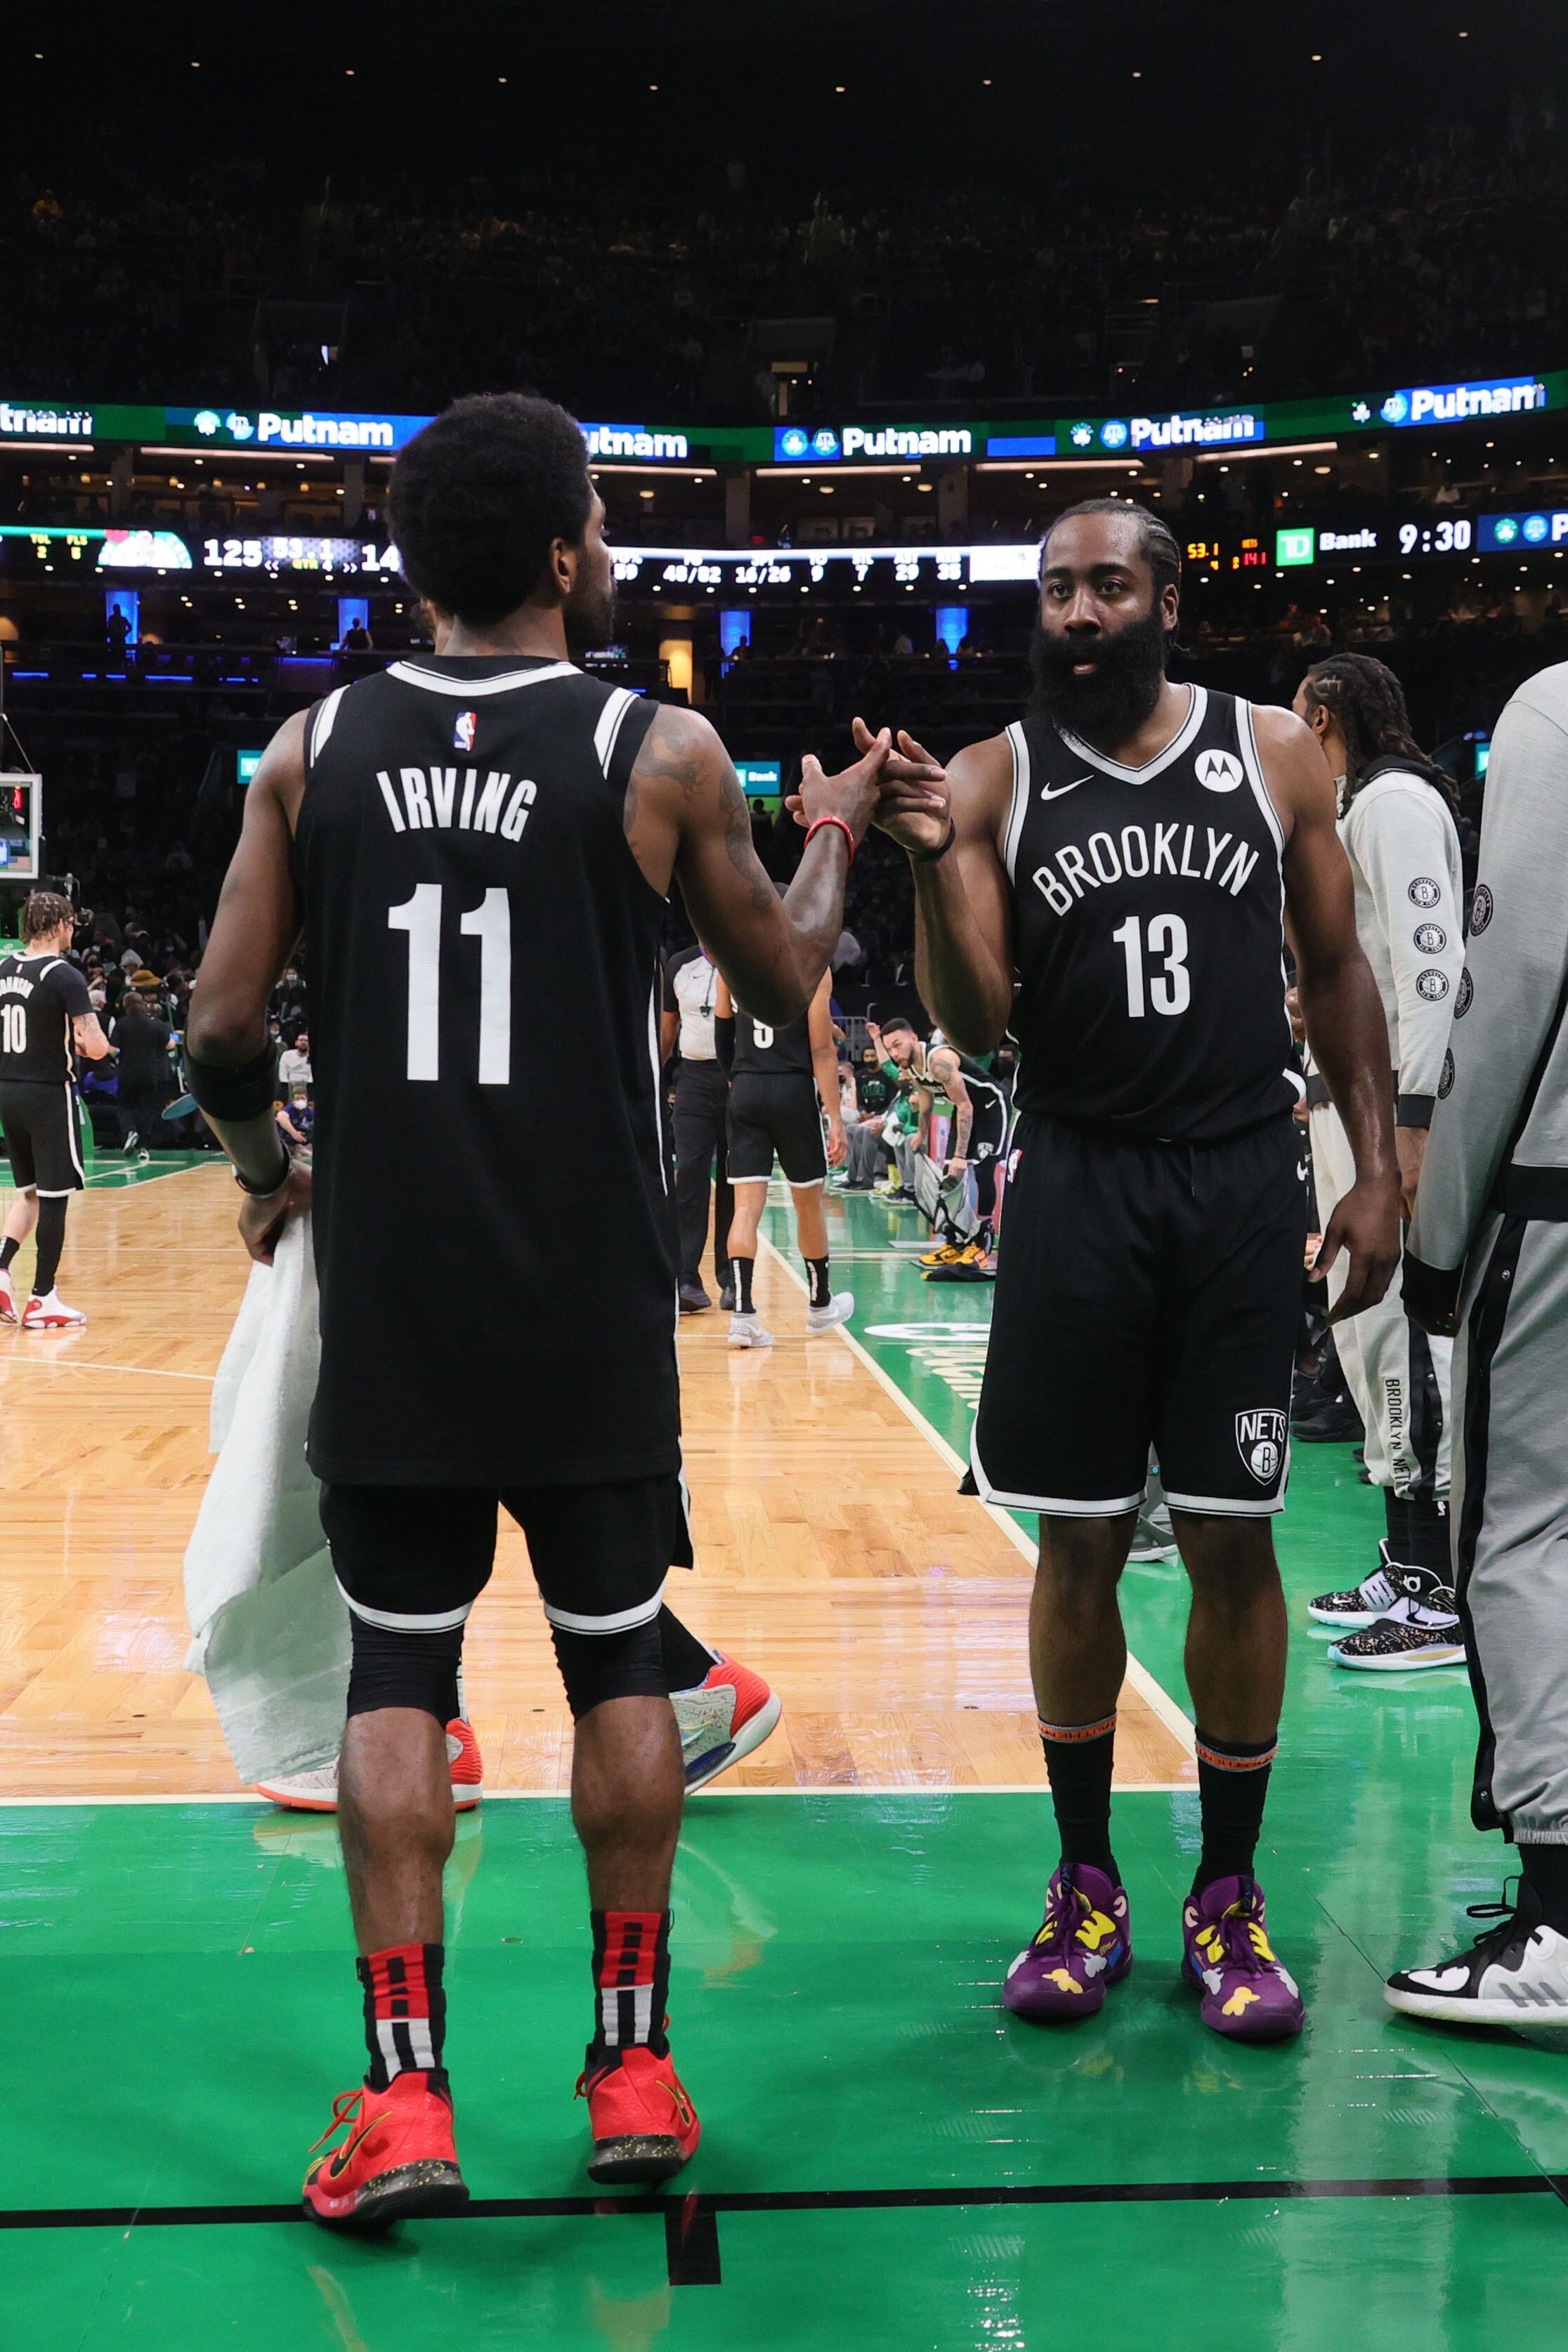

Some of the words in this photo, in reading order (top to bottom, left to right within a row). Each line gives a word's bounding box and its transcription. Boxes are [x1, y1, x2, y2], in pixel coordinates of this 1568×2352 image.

[1411, 384, 1545, 420] Putnam
[258, 413, 393, 445] Putnam
[842, 427, 972, 456] Putnam
[1131, 414, 1255, 447] Putnam
[273, 537, 334, 560] 53.1
[1187, 542, 1219, 559] 53.1
[1281, 535, 1310, 558] TD
[1319, 528, 1377, 551] Bank
[1399, 520, 1471, 554] 9:30
[204, 539, 263, 567] 125
[736, 565, 792, 584] 16/26
[855, 564, 869, 582] 7
[748, 771, 778, 782] Bank
[377, 766, 537, 842] IRVING
[1032, 823, 1260, 917] BROOKLYN
[1113, 914, 1191, 1017] 13
[388, 882, 511, 1085] 11
[0, 1004, 27, 1054] 10
[1240, 1413, 1286, 1444] NETS
[1385, 1378, 1403, 1450] BROOKLYN
[1262, 1447, 1271, 1473] B
[1392, 1458, 1411, 1485] NET
